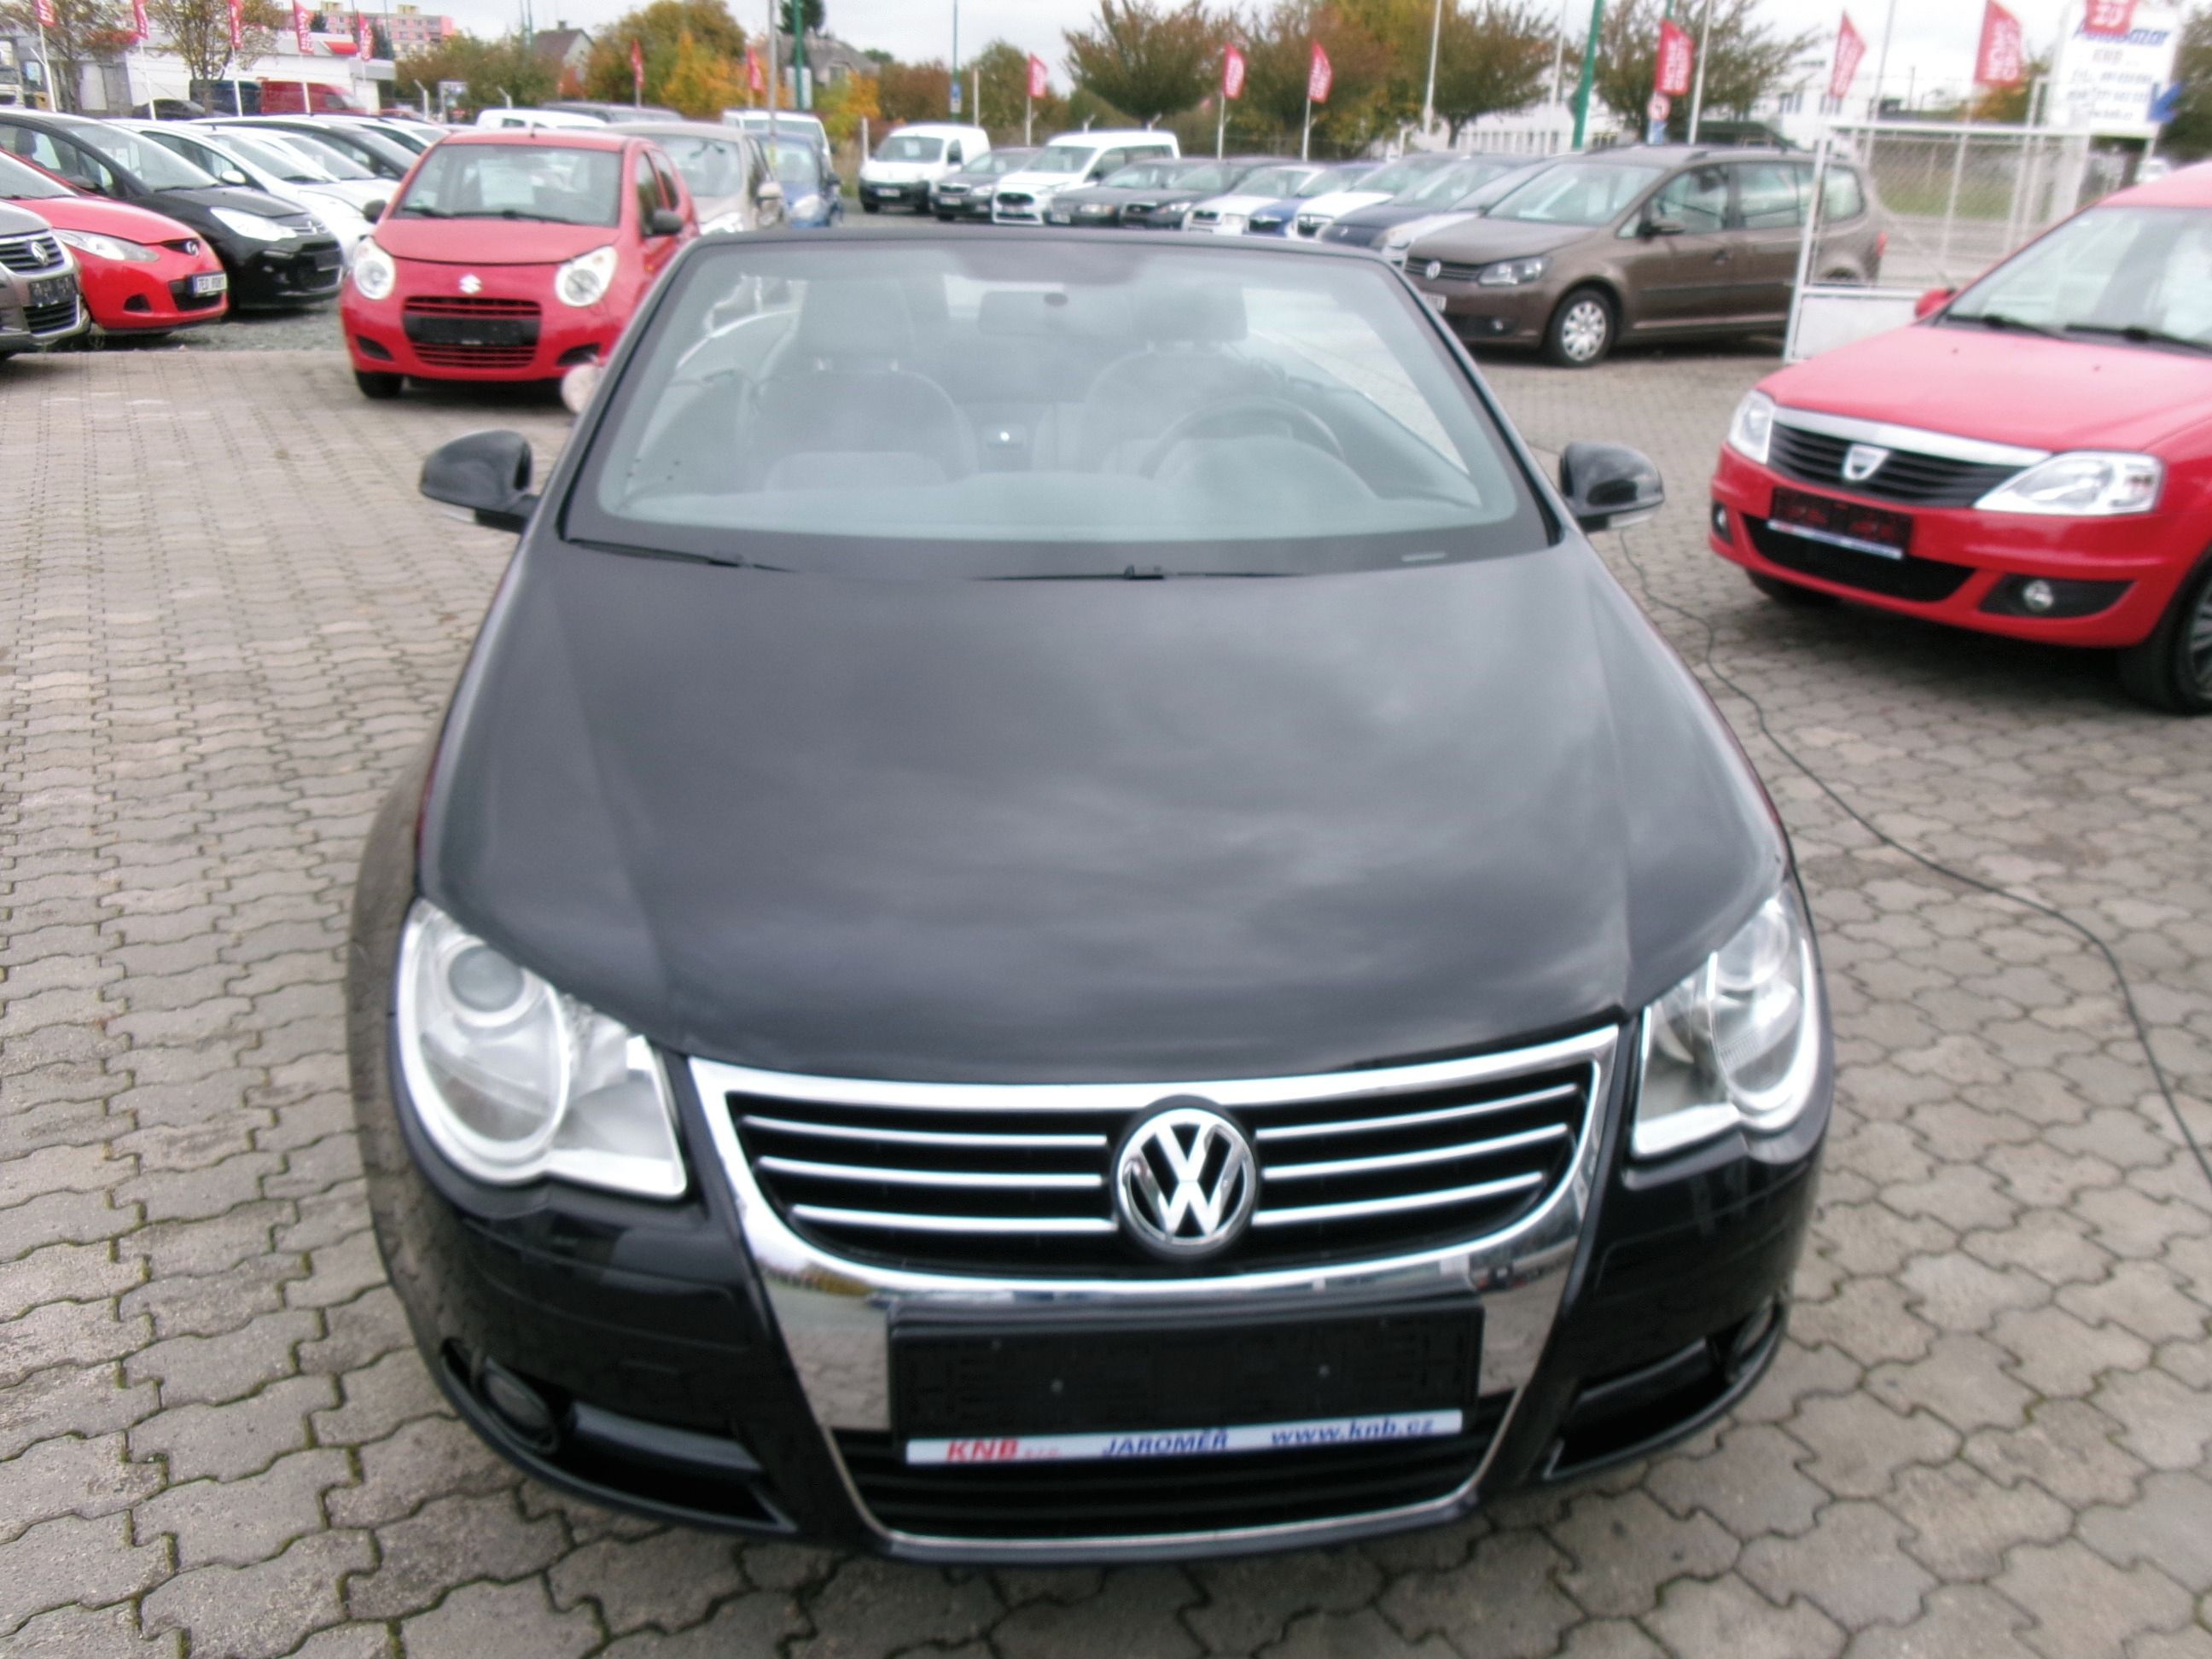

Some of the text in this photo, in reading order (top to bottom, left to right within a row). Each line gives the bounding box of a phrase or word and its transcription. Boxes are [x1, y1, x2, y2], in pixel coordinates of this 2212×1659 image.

[946, 1438, 1020, 1463] KNB
[1102, 1427, 1229, 1457] JAROMĚŘ
[1272, 1417, 1435, 1445] www.knb.cz
